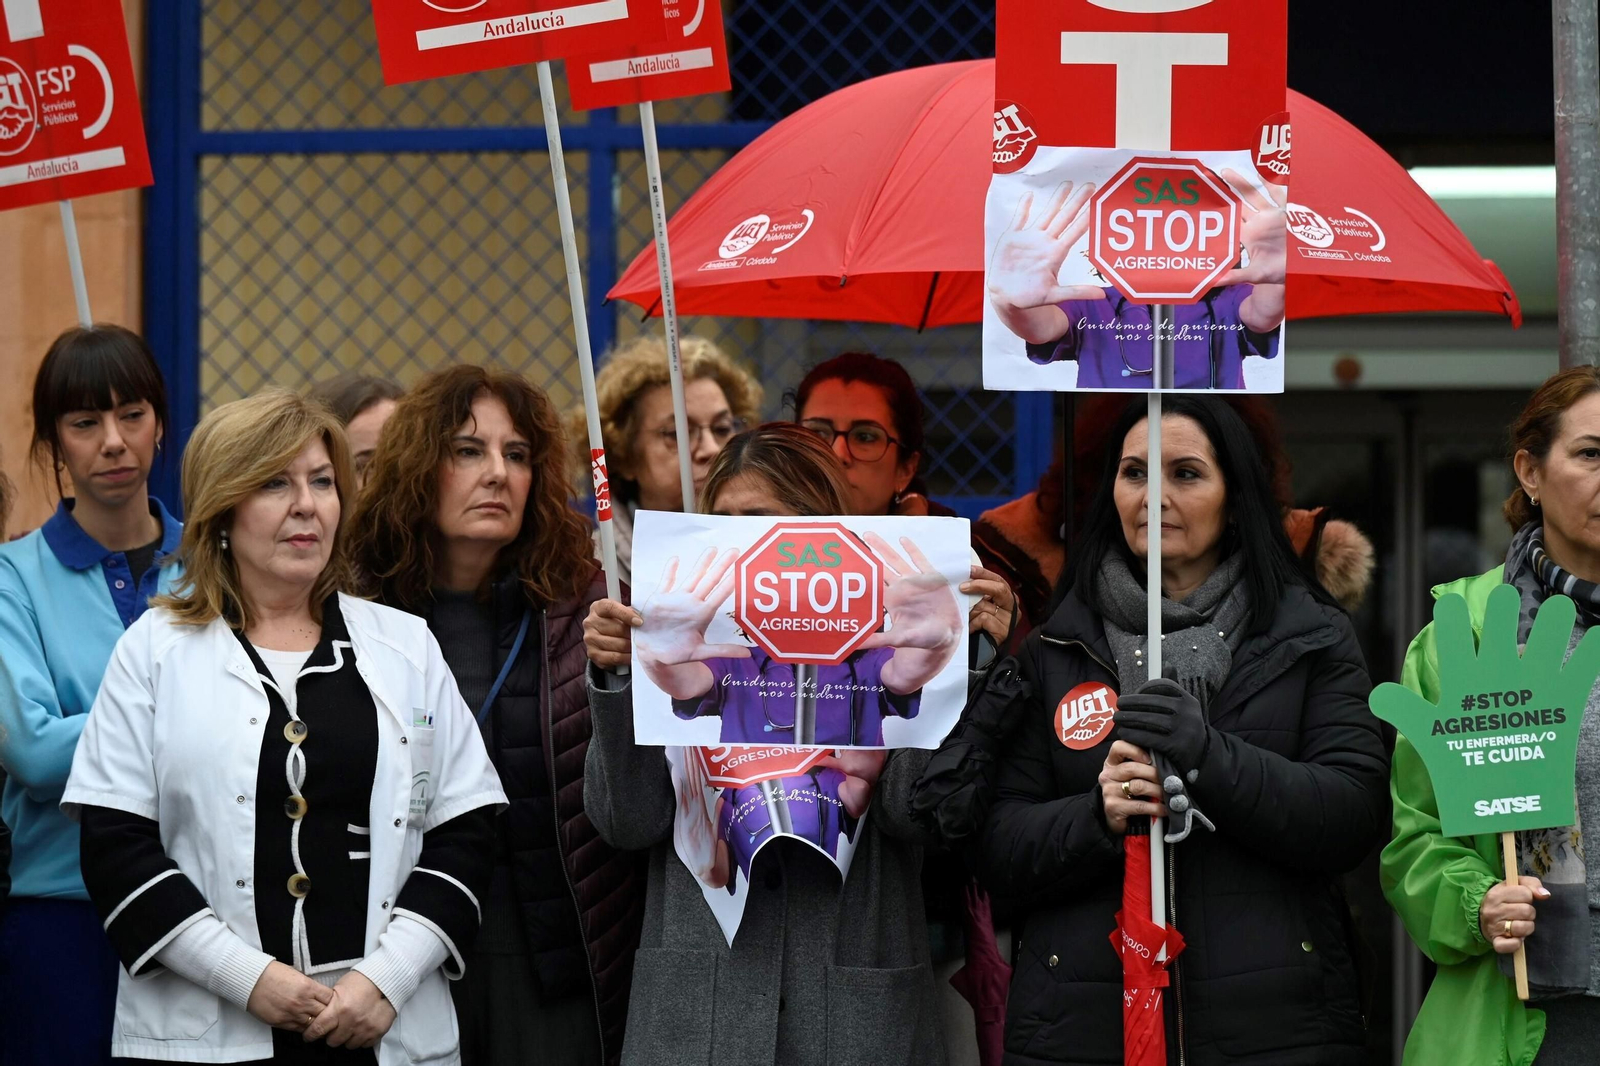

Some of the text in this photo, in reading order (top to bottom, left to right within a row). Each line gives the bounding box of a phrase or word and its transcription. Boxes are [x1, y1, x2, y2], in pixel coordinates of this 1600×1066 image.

[483, 12, 565, 38] Andalucía
[627, 54, 680, 75] Andalucía
[36, 65, 76, 97] FSP
[42, 99, 76, 113] Servicios
[43, 111, 78, 126] Públicos
[27, 158, 79, 179] Andalucía
[1134, 176, 1200, 205] SAS
[770, 221, 804, 232] Servicios
[1107, 208, 1224, 252] STOP
[1327, 217, 1368, 228] Servicios
[1335, 227, 1373, 238] Públicos
[746, 257, 777, 266] Córdoba
[1113, 256, 1216, 270] AGRESIONES
[1354, 253, 1391, 263] Córdoba
[1157, 318, 1175, 331] de
[1115, 330, 1204, 341] nos cuidan
[777, 541, 842, 568] SAS
[753, 571, 867, 614] STOP
[758, 617, 859, 632] AGRESIONES
[800, 677, 817, 690] de
[758, 688, 846, 700] nos cuidan
[1461, 689, 1533, 711] #STOP
[1061, 687, 1109, 731] UGT
[1431, 707, 1567, 736] AGRESIONES
[1447, 731, 1557, 751] TU ENFERMERA/O
[1461, 745, 1545, 766] TE CUIDA
[1474, 795, 1542, 817] SATSE
